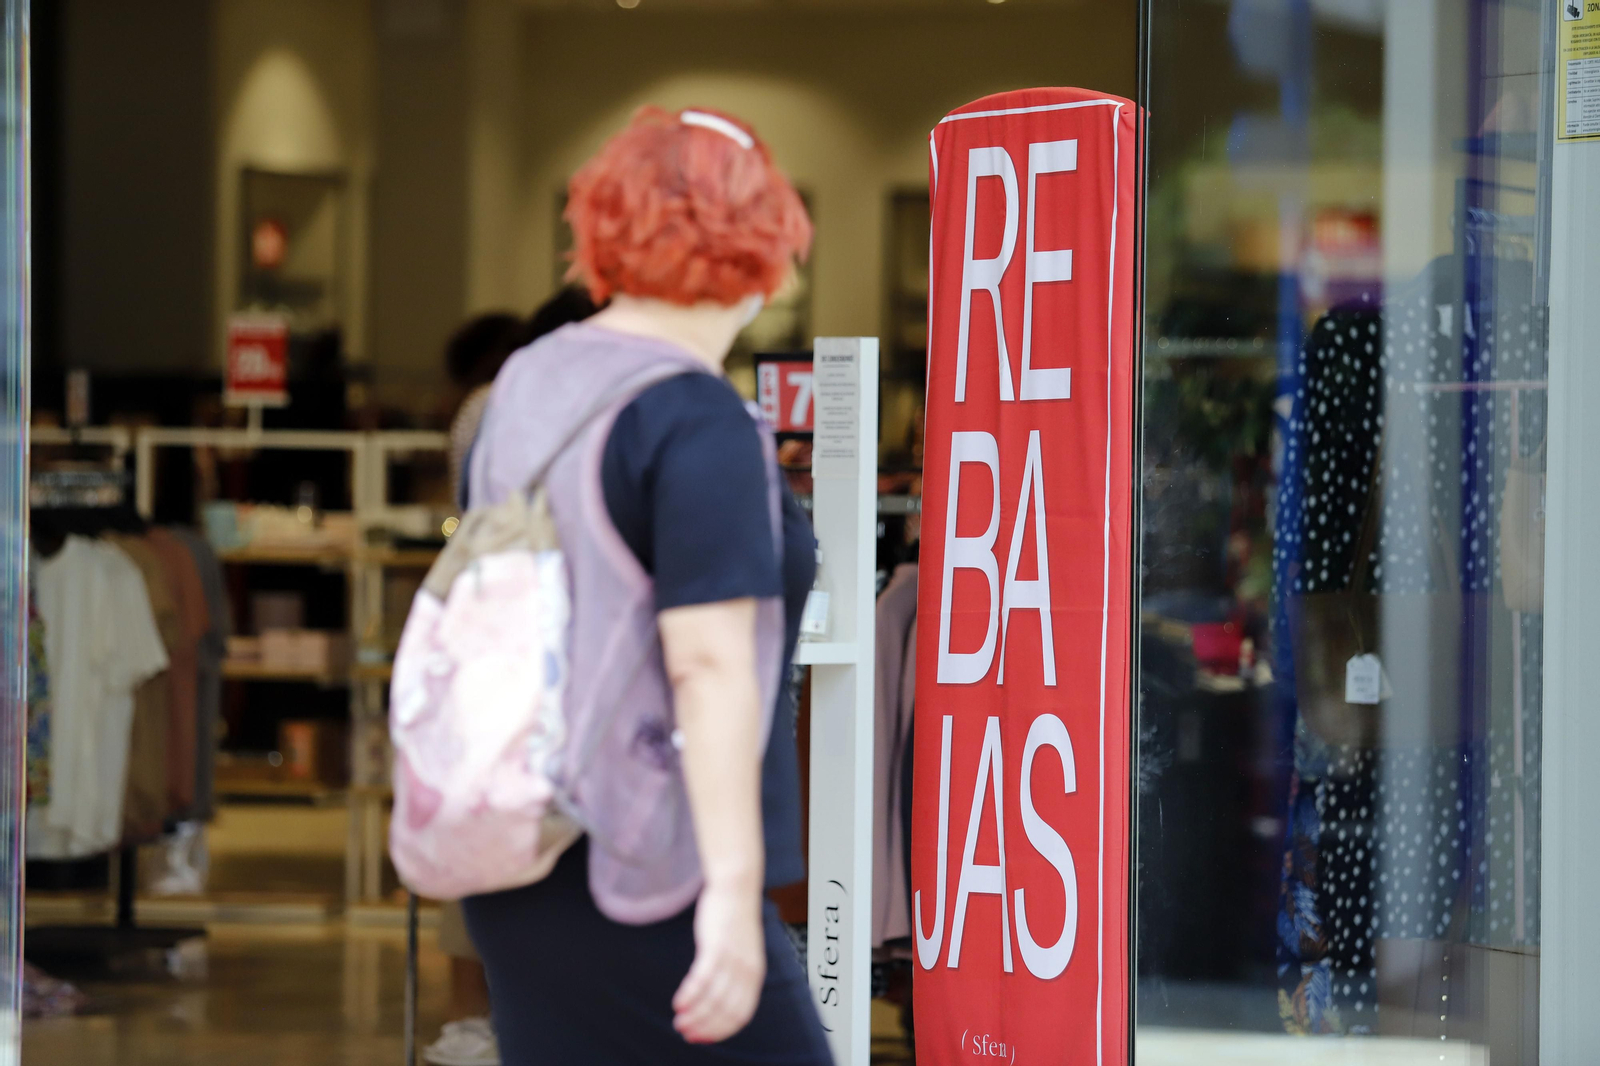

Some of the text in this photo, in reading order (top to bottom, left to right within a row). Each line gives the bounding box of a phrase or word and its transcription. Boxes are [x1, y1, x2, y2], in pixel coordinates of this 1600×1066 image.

[1587, 3, 1600, 13] ZON
[955, 139, 1078, 402] RE
[936, 430, 1056, 686] BA
[915, 713, 1078, 980] JAS
